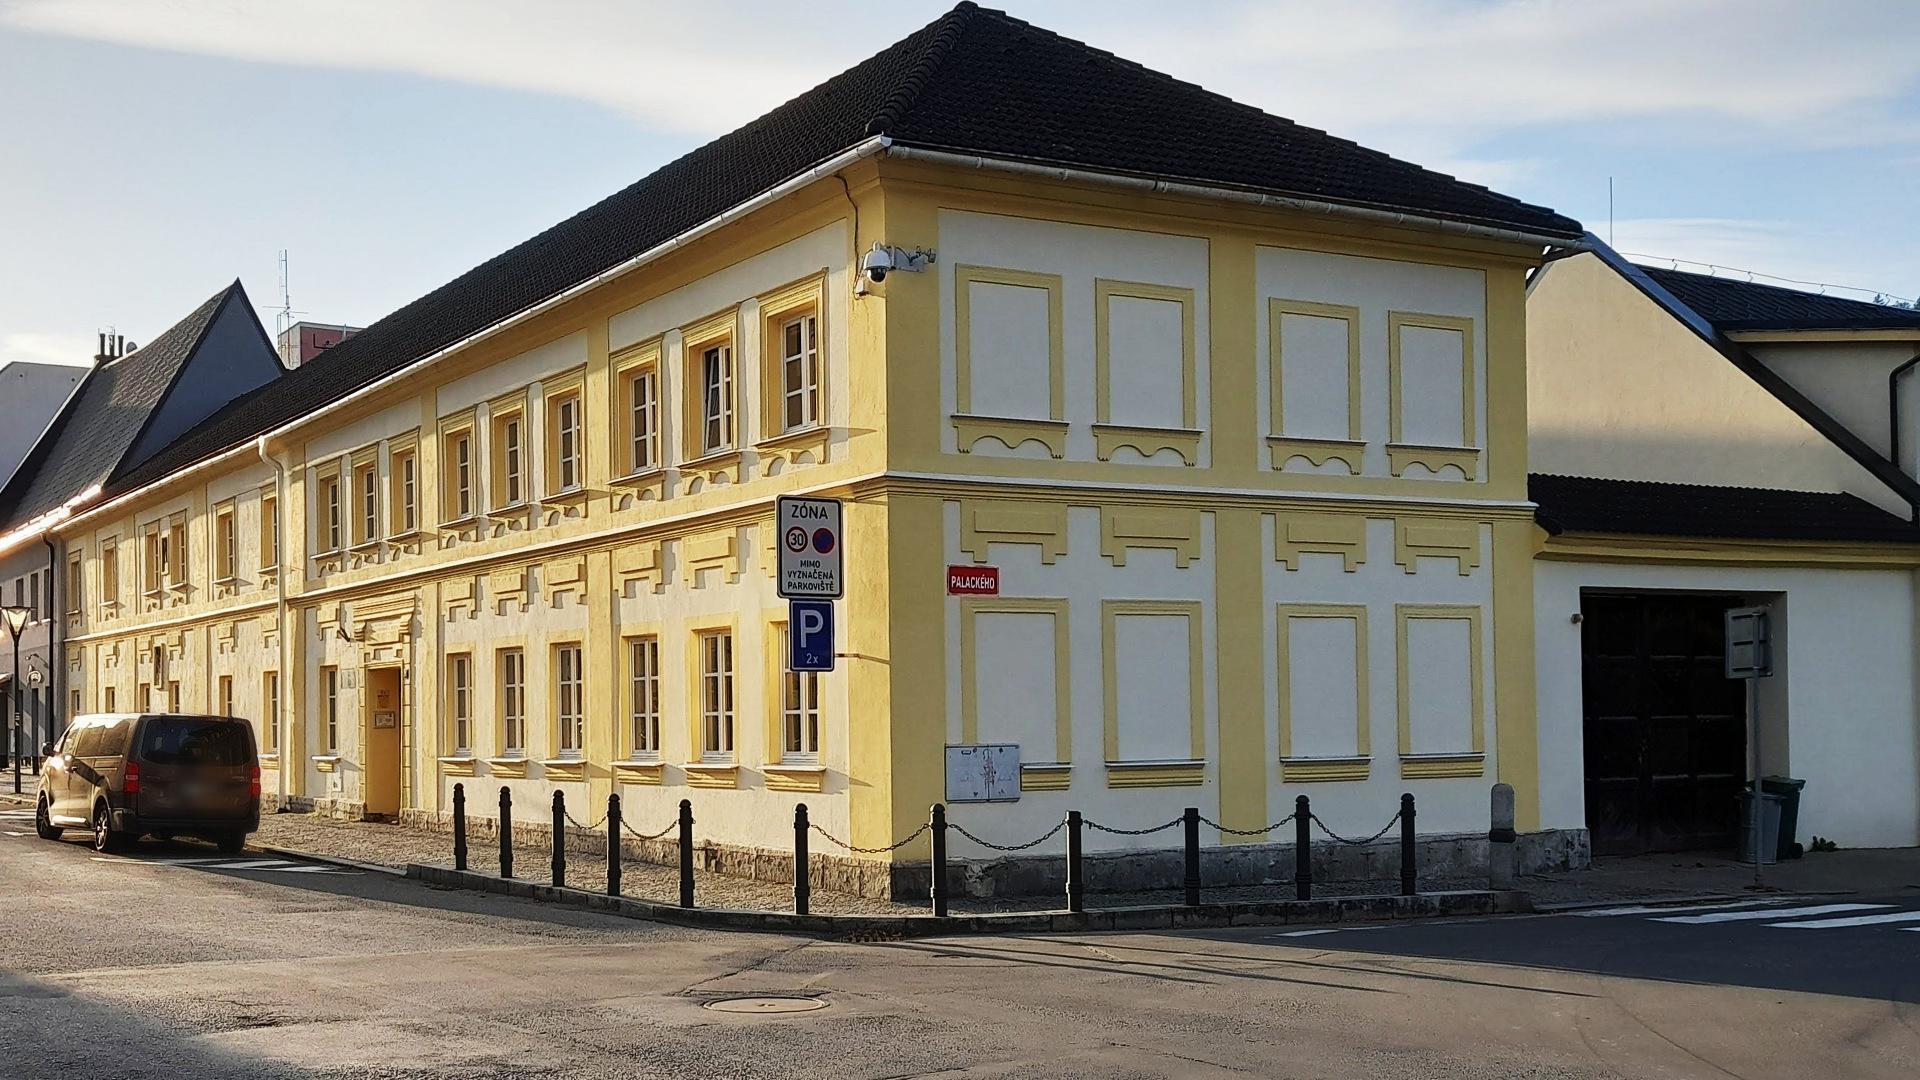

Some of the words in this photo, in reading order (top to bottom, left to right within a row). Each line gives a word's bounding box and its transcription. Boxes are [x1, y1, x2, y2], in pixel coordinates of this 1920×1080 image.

[791, 502, 829, 520] ZÓNA
[790, 533, 804, 547] 30
[800, 559, 821, 569] MIMO
[787, 569, 834, 580] VYZNAČENÁ
[951, 574, 995, 590] PALACKÉHO
[799, 609, 824, 648] P
[806, 652, 819, 664] 2x
